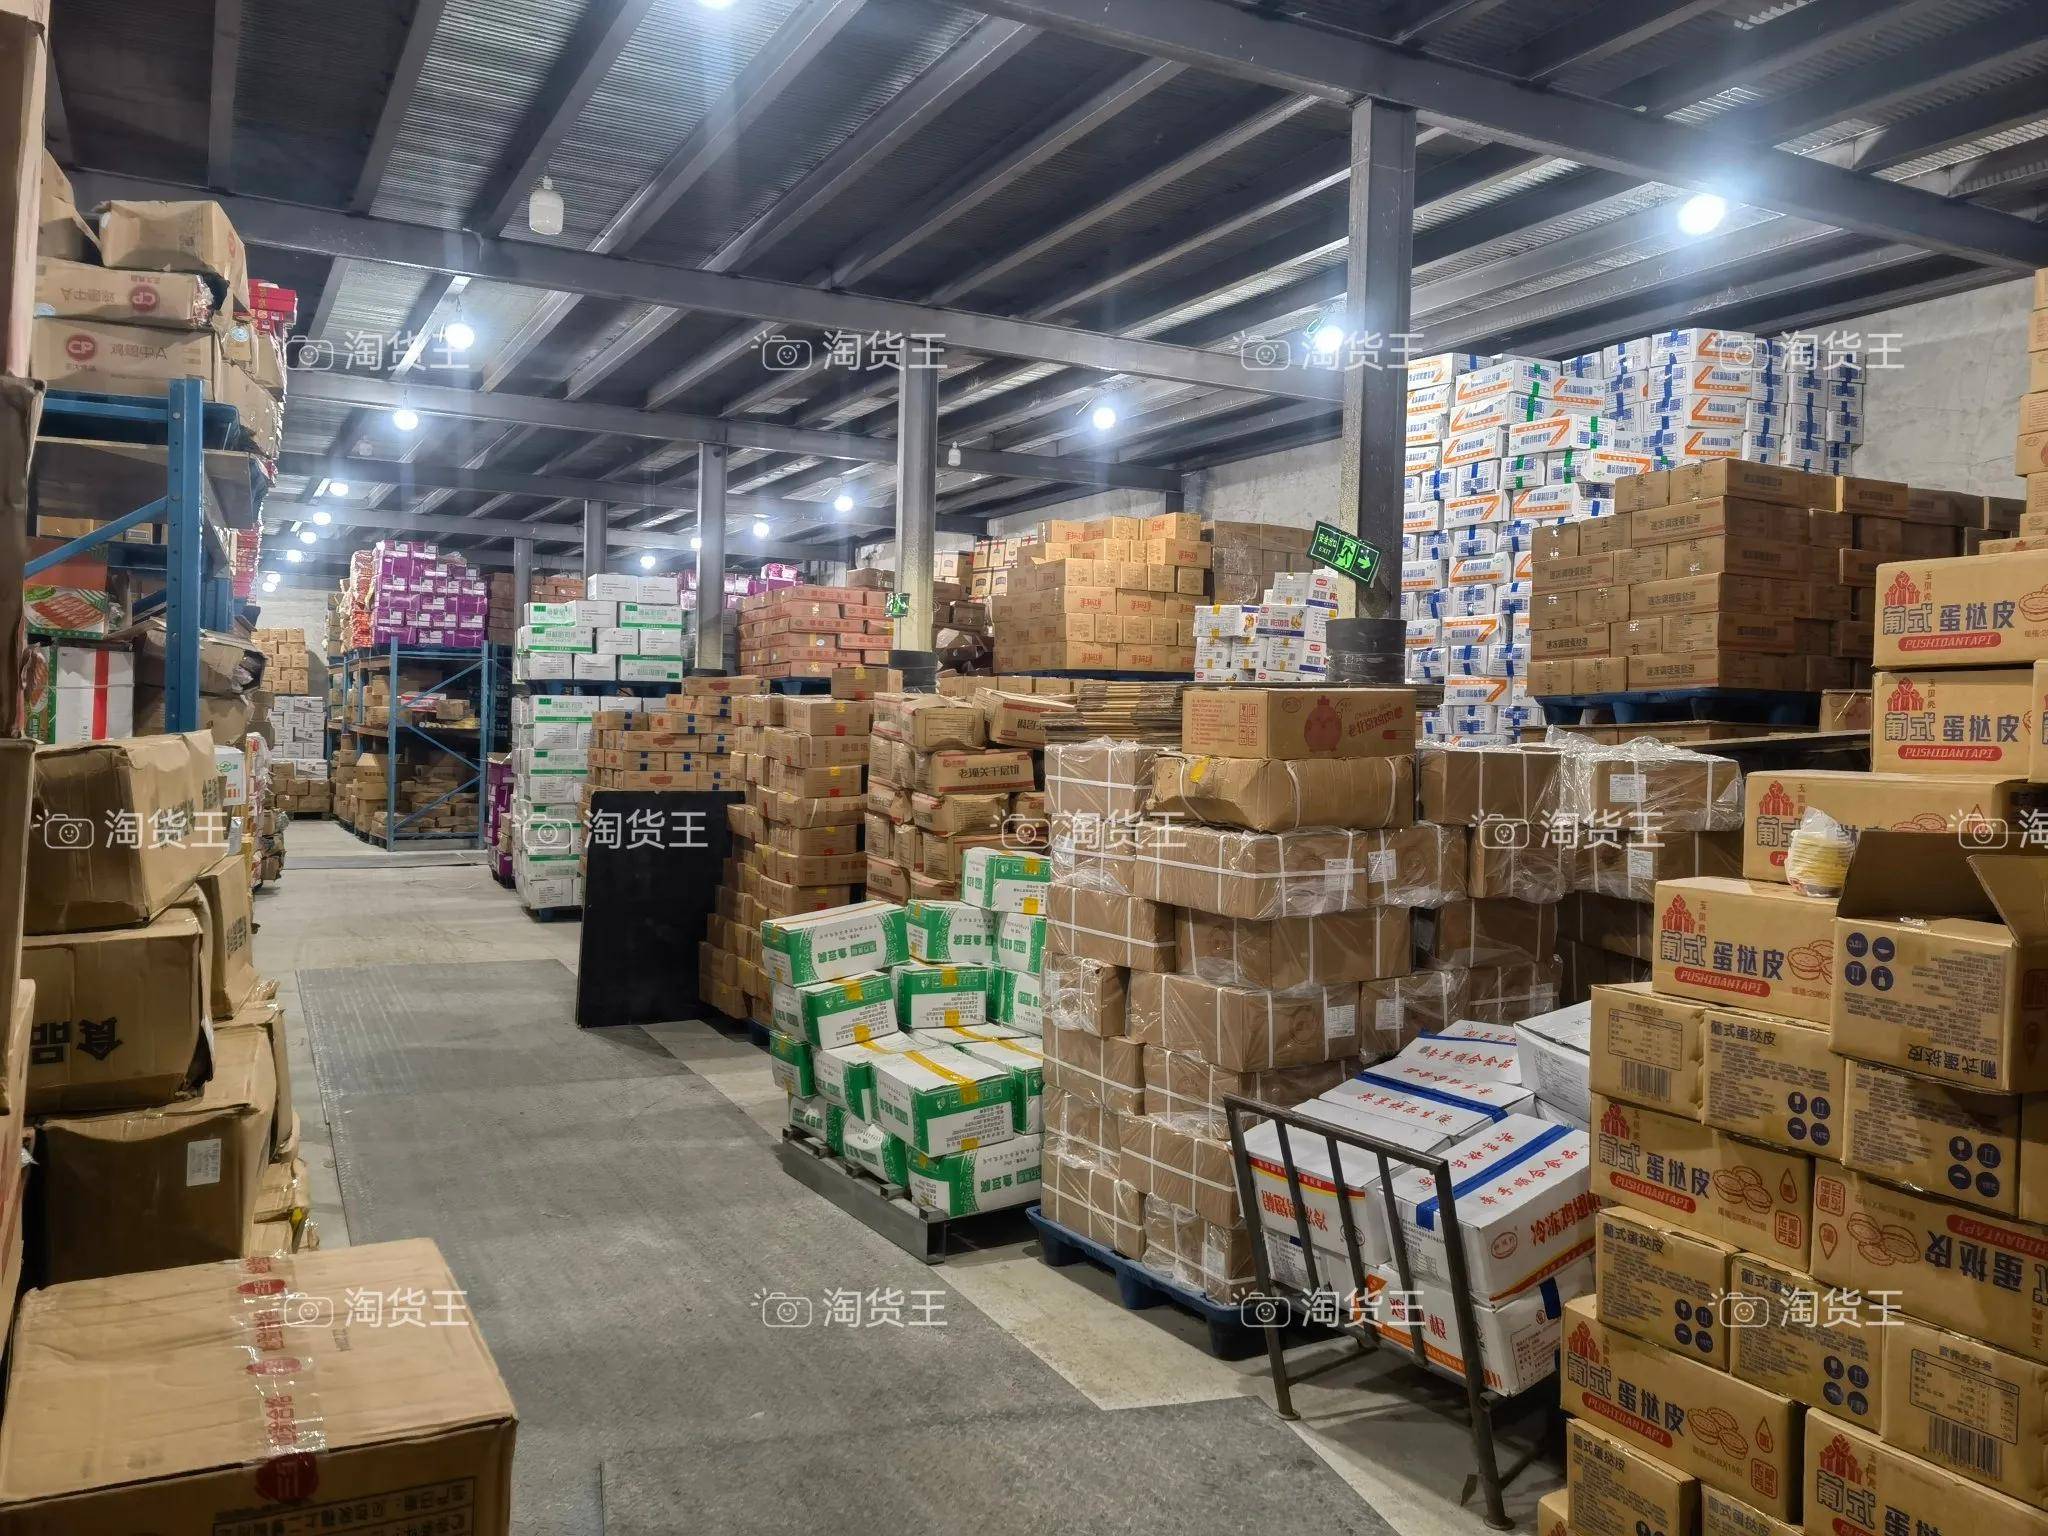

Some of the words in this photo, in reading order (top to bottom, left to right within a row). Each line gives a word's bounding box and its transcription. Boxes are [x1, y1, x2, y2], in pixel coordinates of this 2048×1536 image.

[1318, 547, 1331, 556] EXIT
[1904, 634, 1993, 650] PUSHIDANTAPI
[1904, 747, 1994, 759] PUSHIDANTAPI
[1679, 970, 1763, 995] PUSHIDANTAPI
